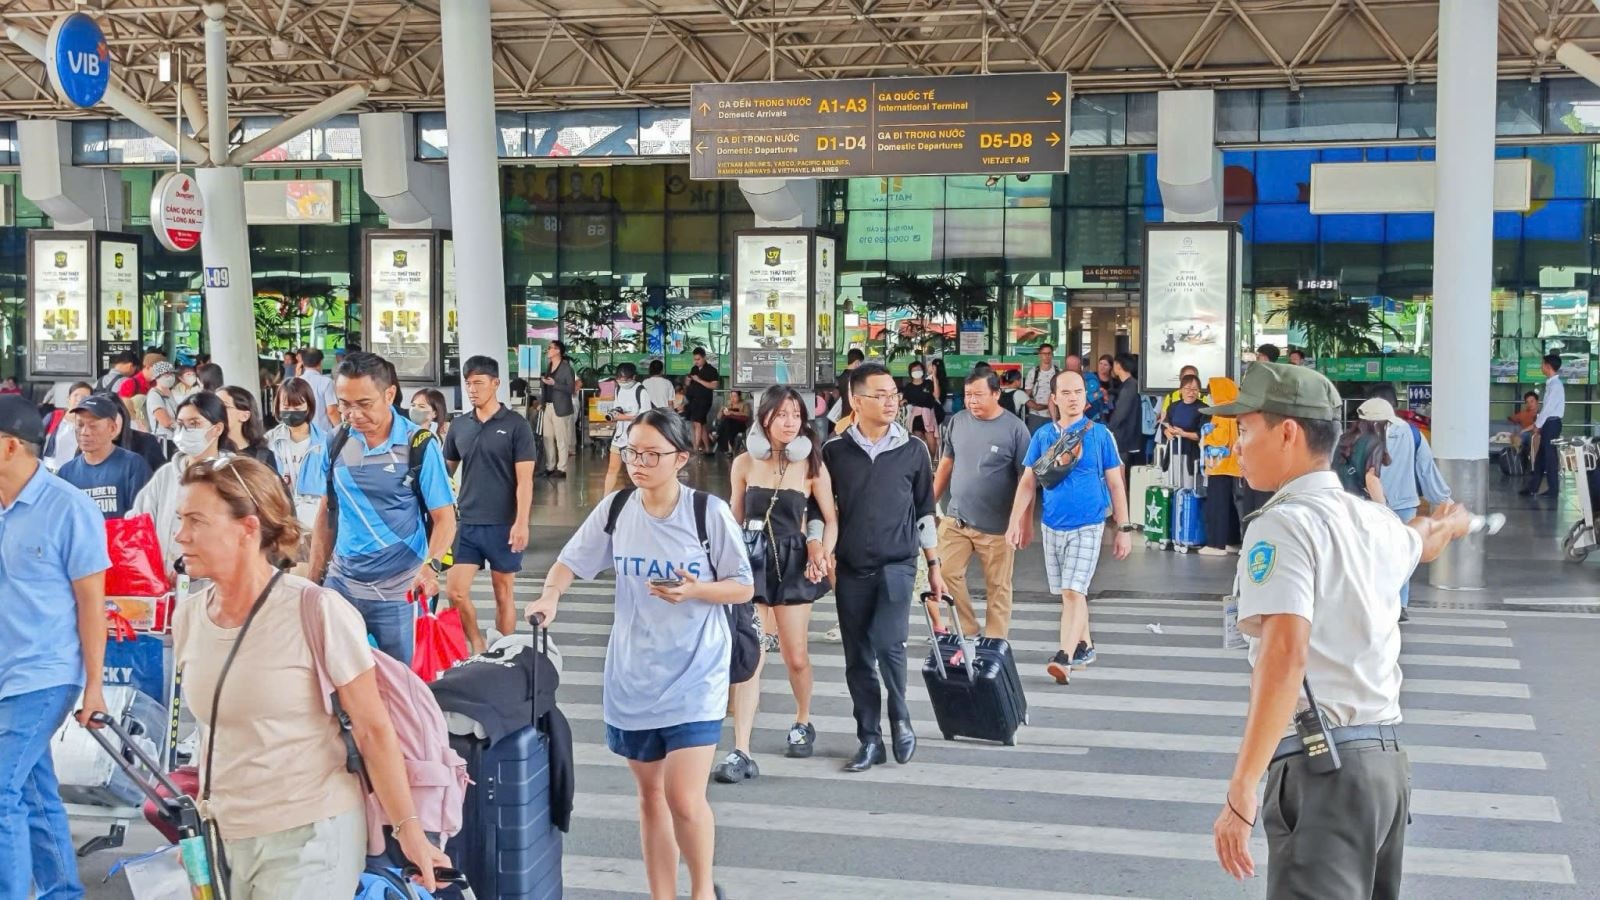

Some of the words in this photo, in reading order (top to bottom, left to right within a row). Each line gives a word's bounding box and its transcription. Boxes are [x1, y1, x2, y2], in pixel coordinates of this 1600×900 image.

[67, 50, 100, 76] VIB
[879, 93, 892, 101] GA
[894, 90, 920, 101] QUỐC
[923, 89, 936, 100] TẾ
[732, 99, 751, 108] ĐẾN
[754, 99, 784, 107] TRONG
[786, 97, 812, 106] NƯỚC
[818, 98, 868, 113] A1-A3
[878, 103, 930, 112] International
[932, 102, 968, 110] Terminal
[774, 133, 800, 142] NƯỚC
[904, 130, 936, 138] TRONG
[938, 129, 966, 138] NƯỚC
[818, 136, 868, 150] D1-D4
[980, 133, 1033, 148] D5-D8
[754, 146, 798, 155] Departures
[918, 142, 964, 151] Departures
[982, 156, 1014, 164] VIETJET
[1016, 156, 1030, 164] AIR
[1307, 280, 1332, 288] 16:23
[106, 486, 116, 495] TO
[614, 556, 700, 579] TITANS
